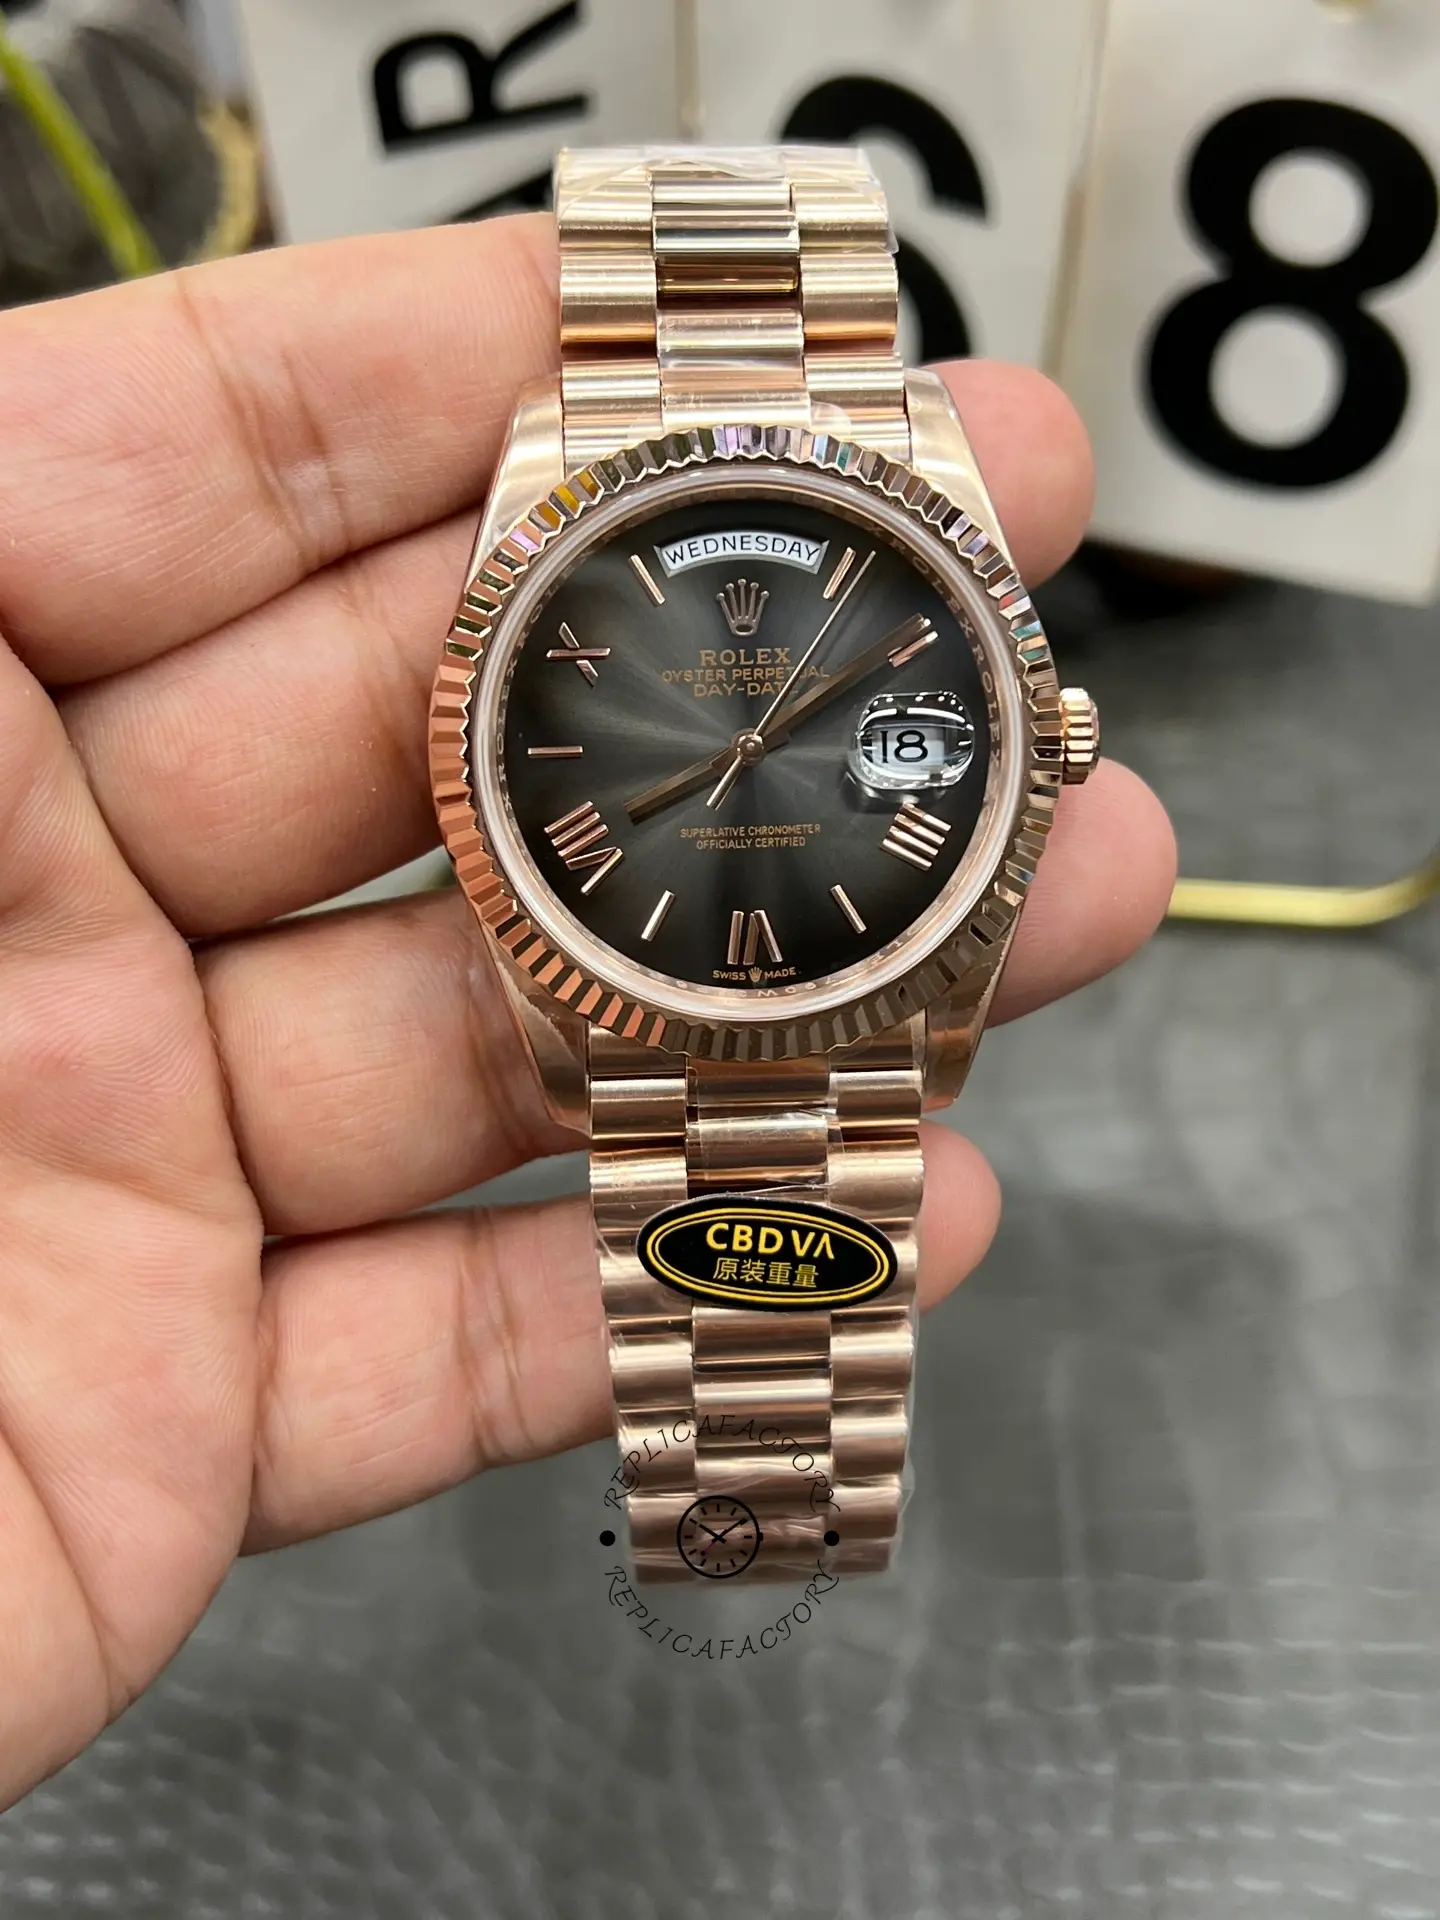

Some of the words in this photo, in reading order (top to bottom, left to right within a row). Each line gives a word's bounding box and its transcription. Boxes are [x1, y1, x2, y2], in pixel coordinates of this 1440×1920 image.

[1148, 97, 1439, 491] 8
[664, 534, 821, 565] WEDNESDAY
[700, 647, 791, 667] ROLEX
[661, 668, 727, 683] OYSTER
[693, 681, 798, 698] DAY-DAT
[879, 729, 929, 764] 18
[680, 826, 745, 838] SUPERLATIVE
[747, 823, 821, 836] CHRONOMETER
[695, 838, 752, 850] OFFICIALLY
[755, 836, 806, 848] CERTIFIED
[712, 969, 747, 981] SWISS
[764, 966, 797, 980] MADE
[712, 1256, 819, 1289] 原装重量
